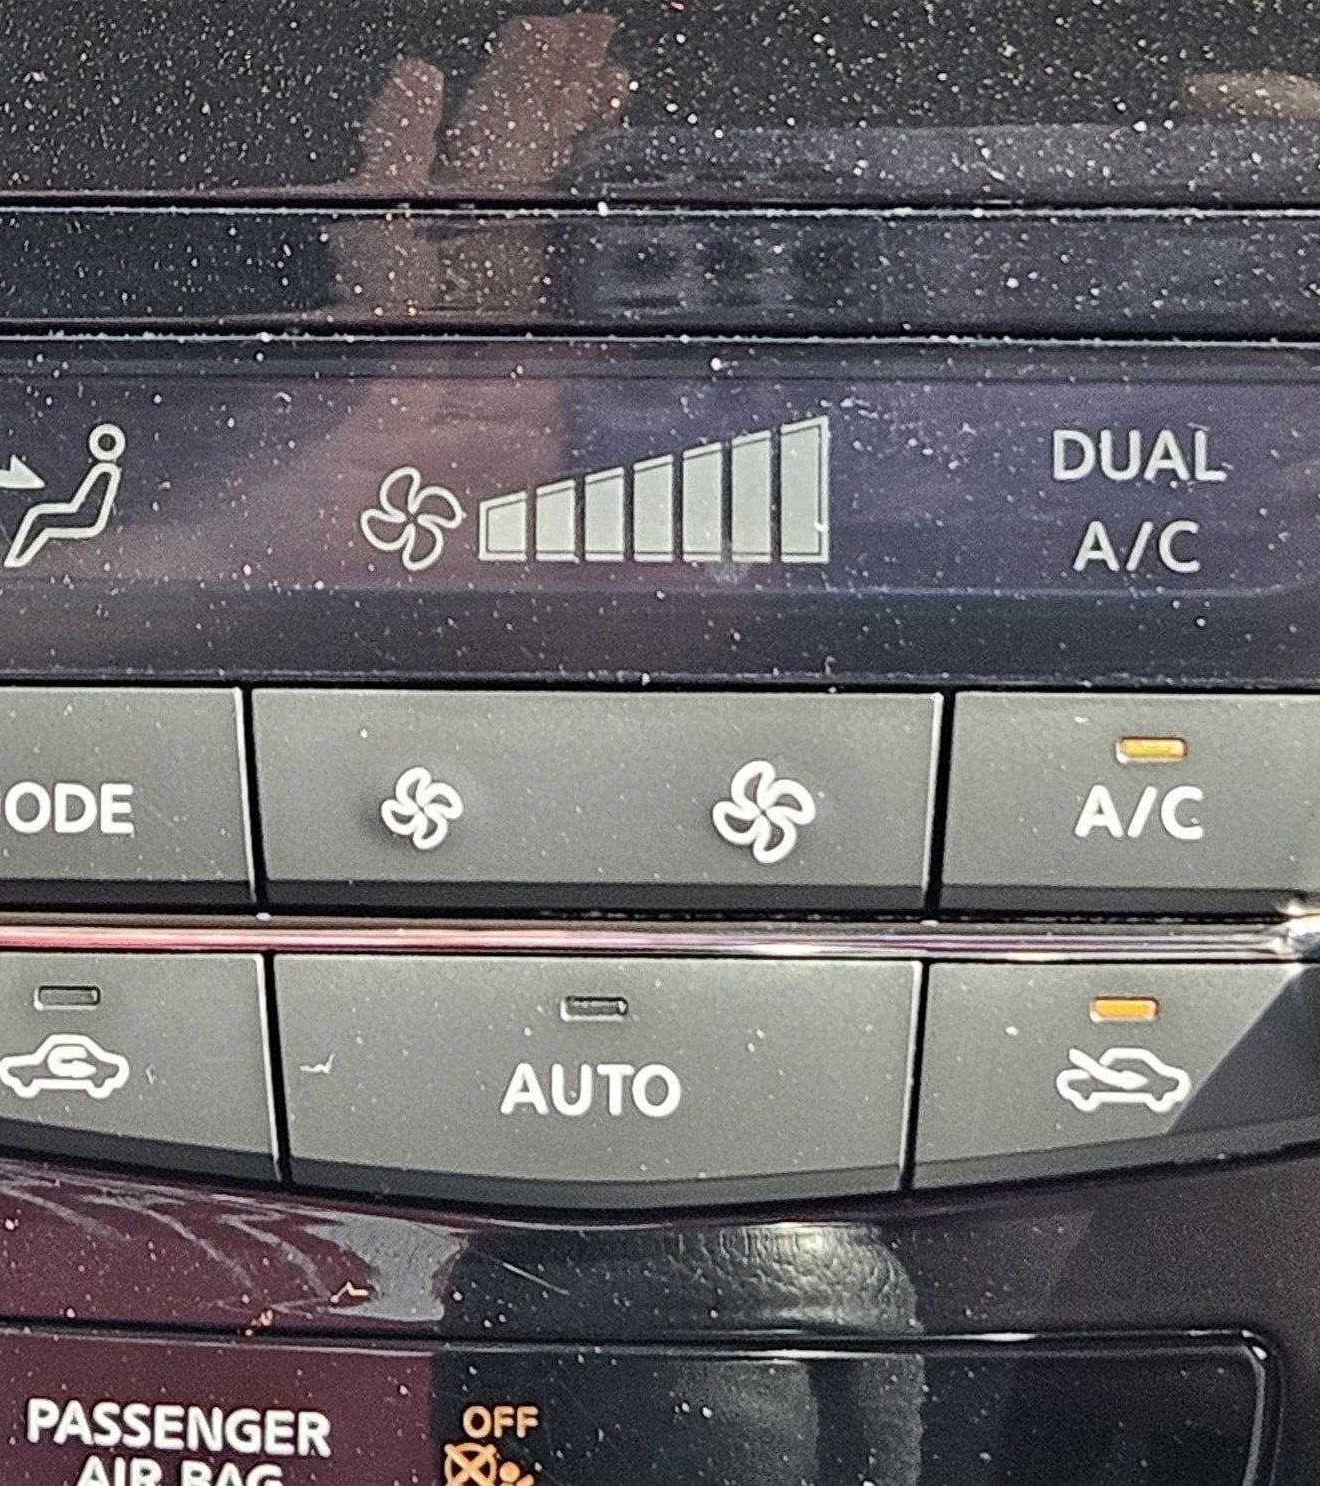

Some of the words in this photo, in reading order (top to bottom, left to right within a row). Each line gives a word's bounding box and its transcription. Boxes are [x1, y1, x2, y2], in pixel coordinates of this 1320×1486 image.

[1054, 431, 1226, 483] DUAL
[1074, 520, 1201, 573] A/C
[1075, 786, 1203, 840] A/C
[500, 1062, 681, 1116] AUTO
[27, 1398, 331, 1458] PASSENGER
[462, 1405, 539, 1440] OFF
